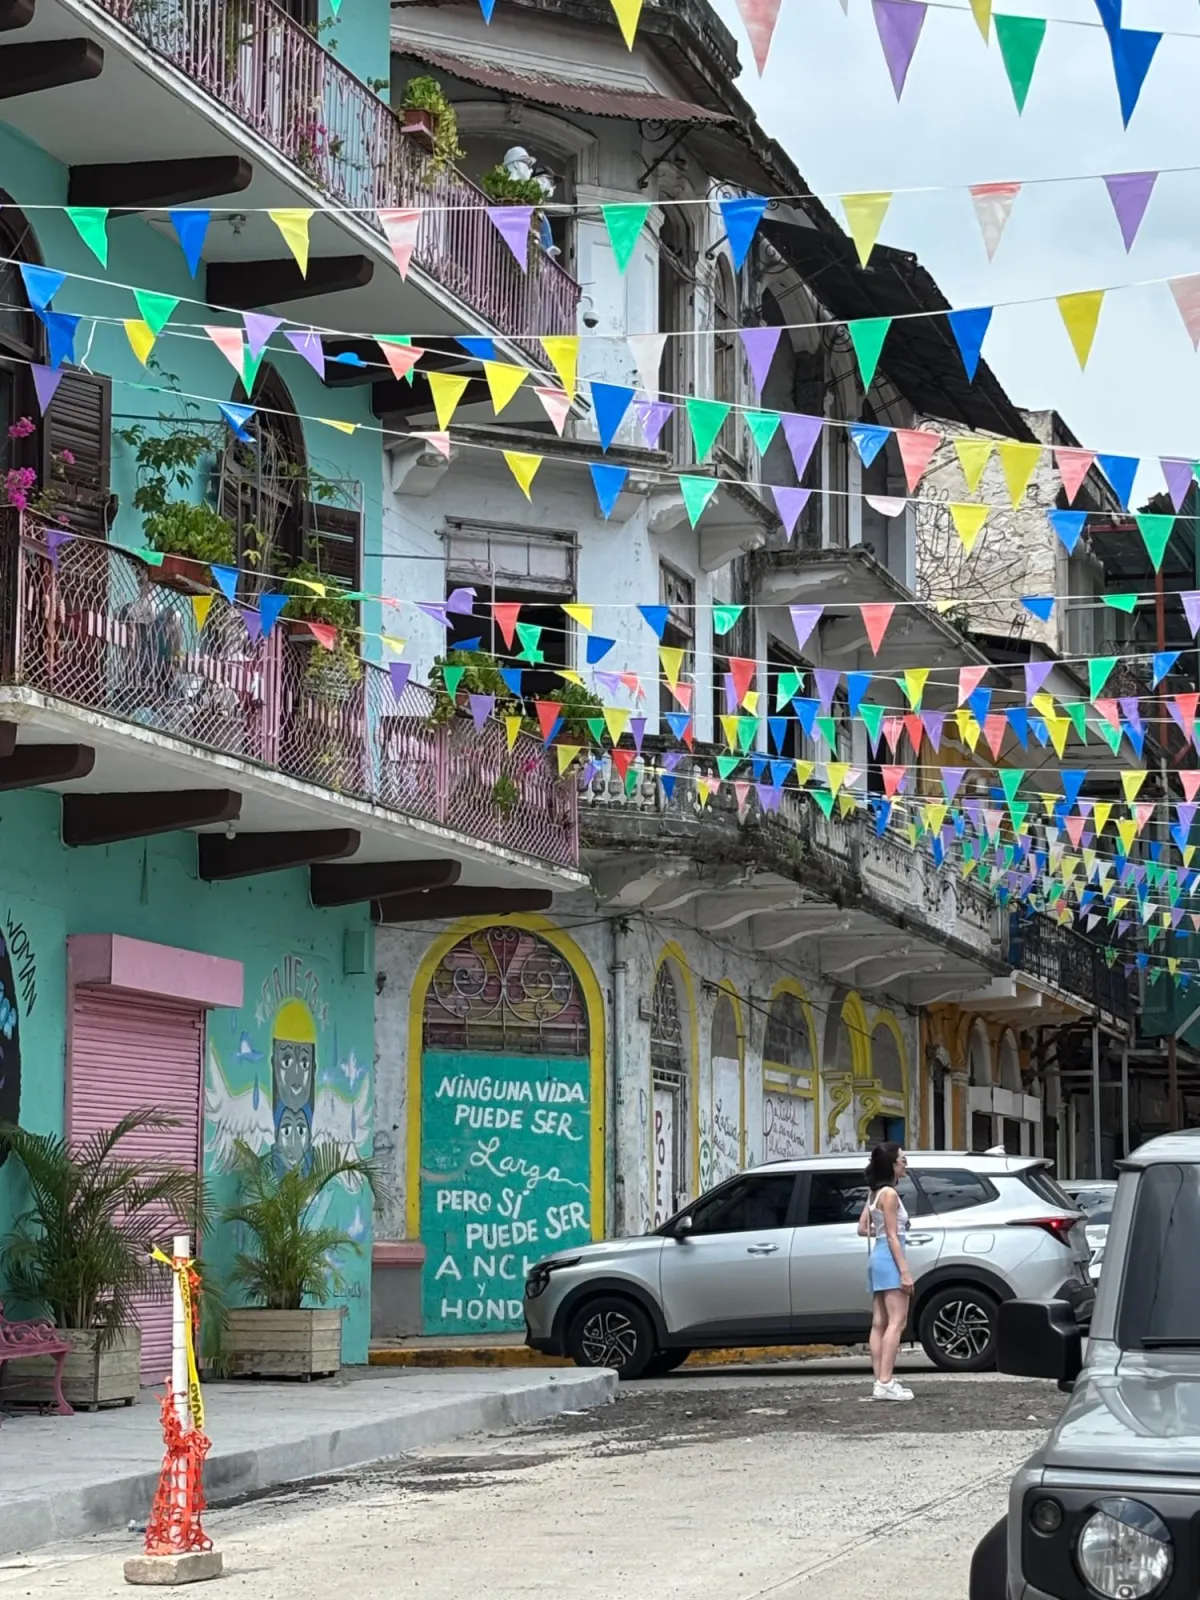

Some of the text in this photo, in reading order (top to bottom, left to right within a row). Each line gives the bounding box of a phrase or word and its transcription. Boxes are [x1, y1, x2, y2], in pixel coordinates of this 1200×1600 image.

[7, 908, 37, 1017] WOMAN
[455, 1104, 584, 1141] PUEDE SER
[437, 1190, 491, 1214] PERO
[466, 1202, 590, 1249] PUEDE SER
